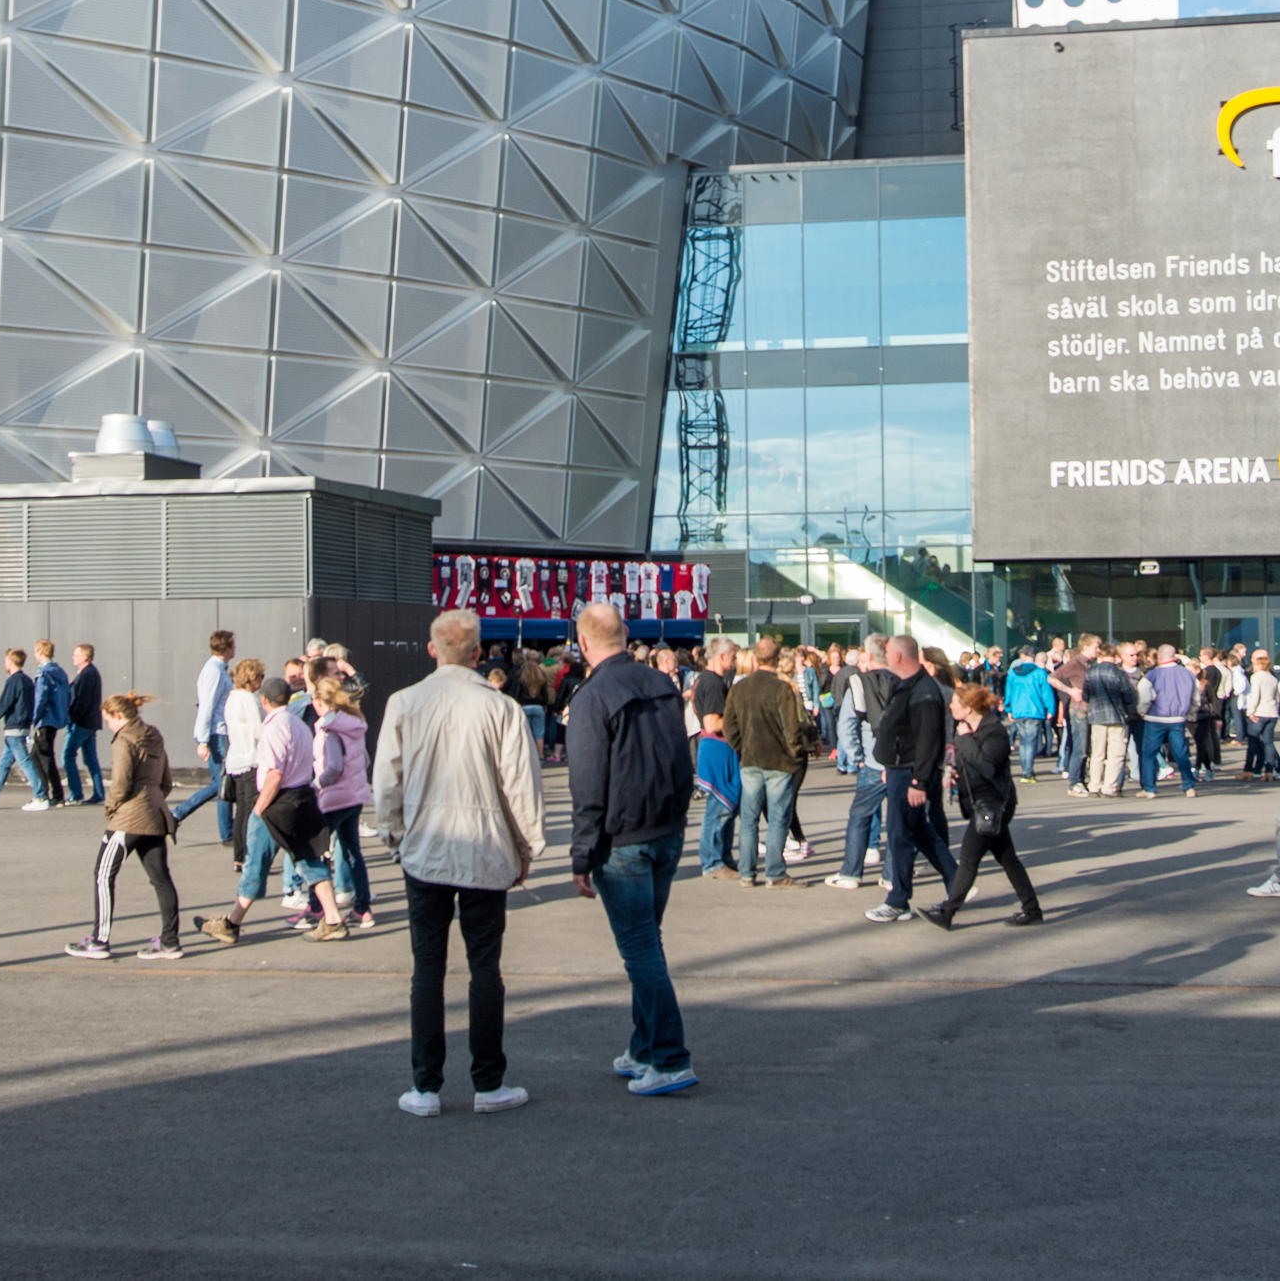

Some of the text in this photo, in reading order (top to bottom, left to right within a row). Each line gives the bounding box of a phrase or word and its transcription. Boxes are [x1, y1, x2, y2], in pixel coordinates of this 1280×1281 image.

[1046, 258, 1156, 283] Stiftelsen
[1165, 252, 1251, 278] Friends
[1047, 295, 1109, 320] såväl
[1117, 293, 1180, 318] skola
[1188, 295, 1236, 315] som
[1047, 332, 1130, 362] stödjer.
[1138, 328, 1227, 354] Namnet
[1236, 326, 1265, 356] på
[1049, 371, 1100, 394] barn
[1109, 369, 1150, 392] ska
[1159, 365, 1241, 391] behöva
[1050, 458, 1166, 488] FRIENDS
[1174, 456, 1271, 485] ARENA
